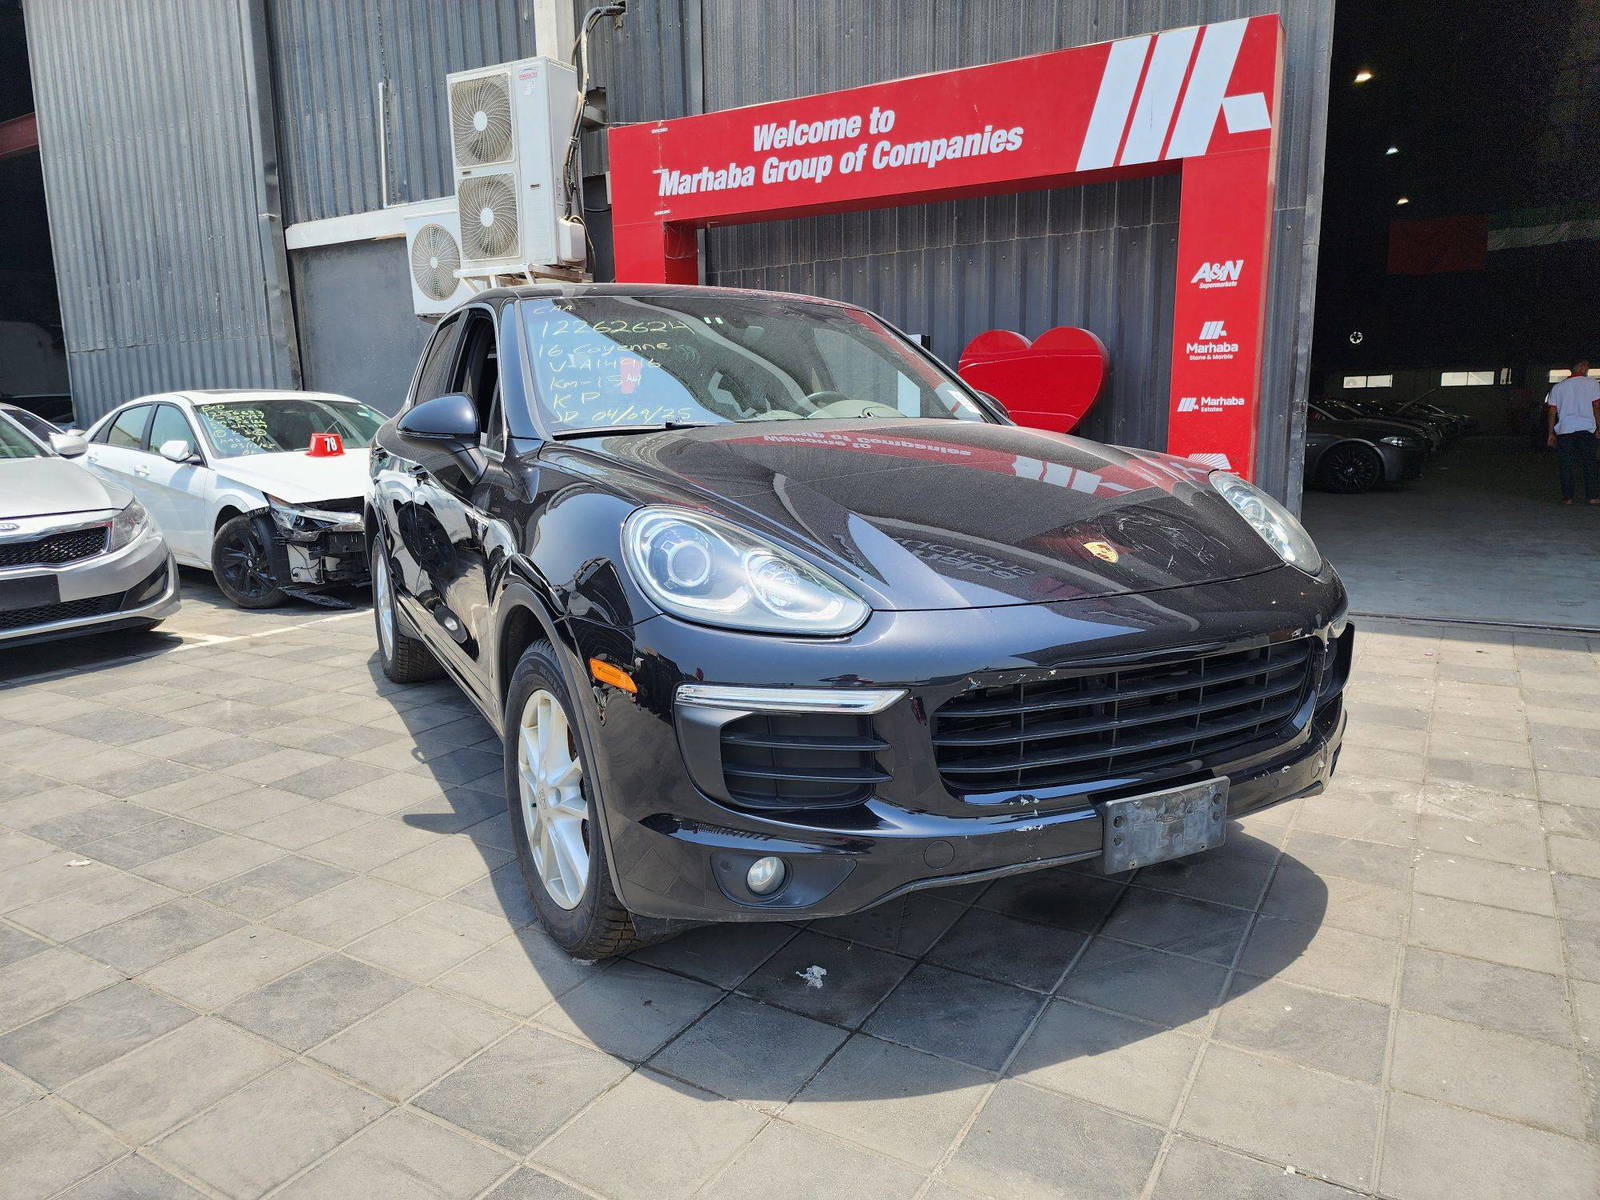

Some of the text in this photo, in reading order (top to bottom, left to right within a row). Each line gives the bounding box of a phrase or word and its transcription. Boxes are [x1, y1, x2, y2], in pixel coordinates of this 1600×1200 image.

[753, 106, 896, 152] Welcome to
[658, 125, 1024, 197] Marhaba Group of Companies
[1190, 259, 1244, 284] A&N
[1186, 342, 1239, 354] Marhaba
[1201, 396, 1245, 406] Marhaba
